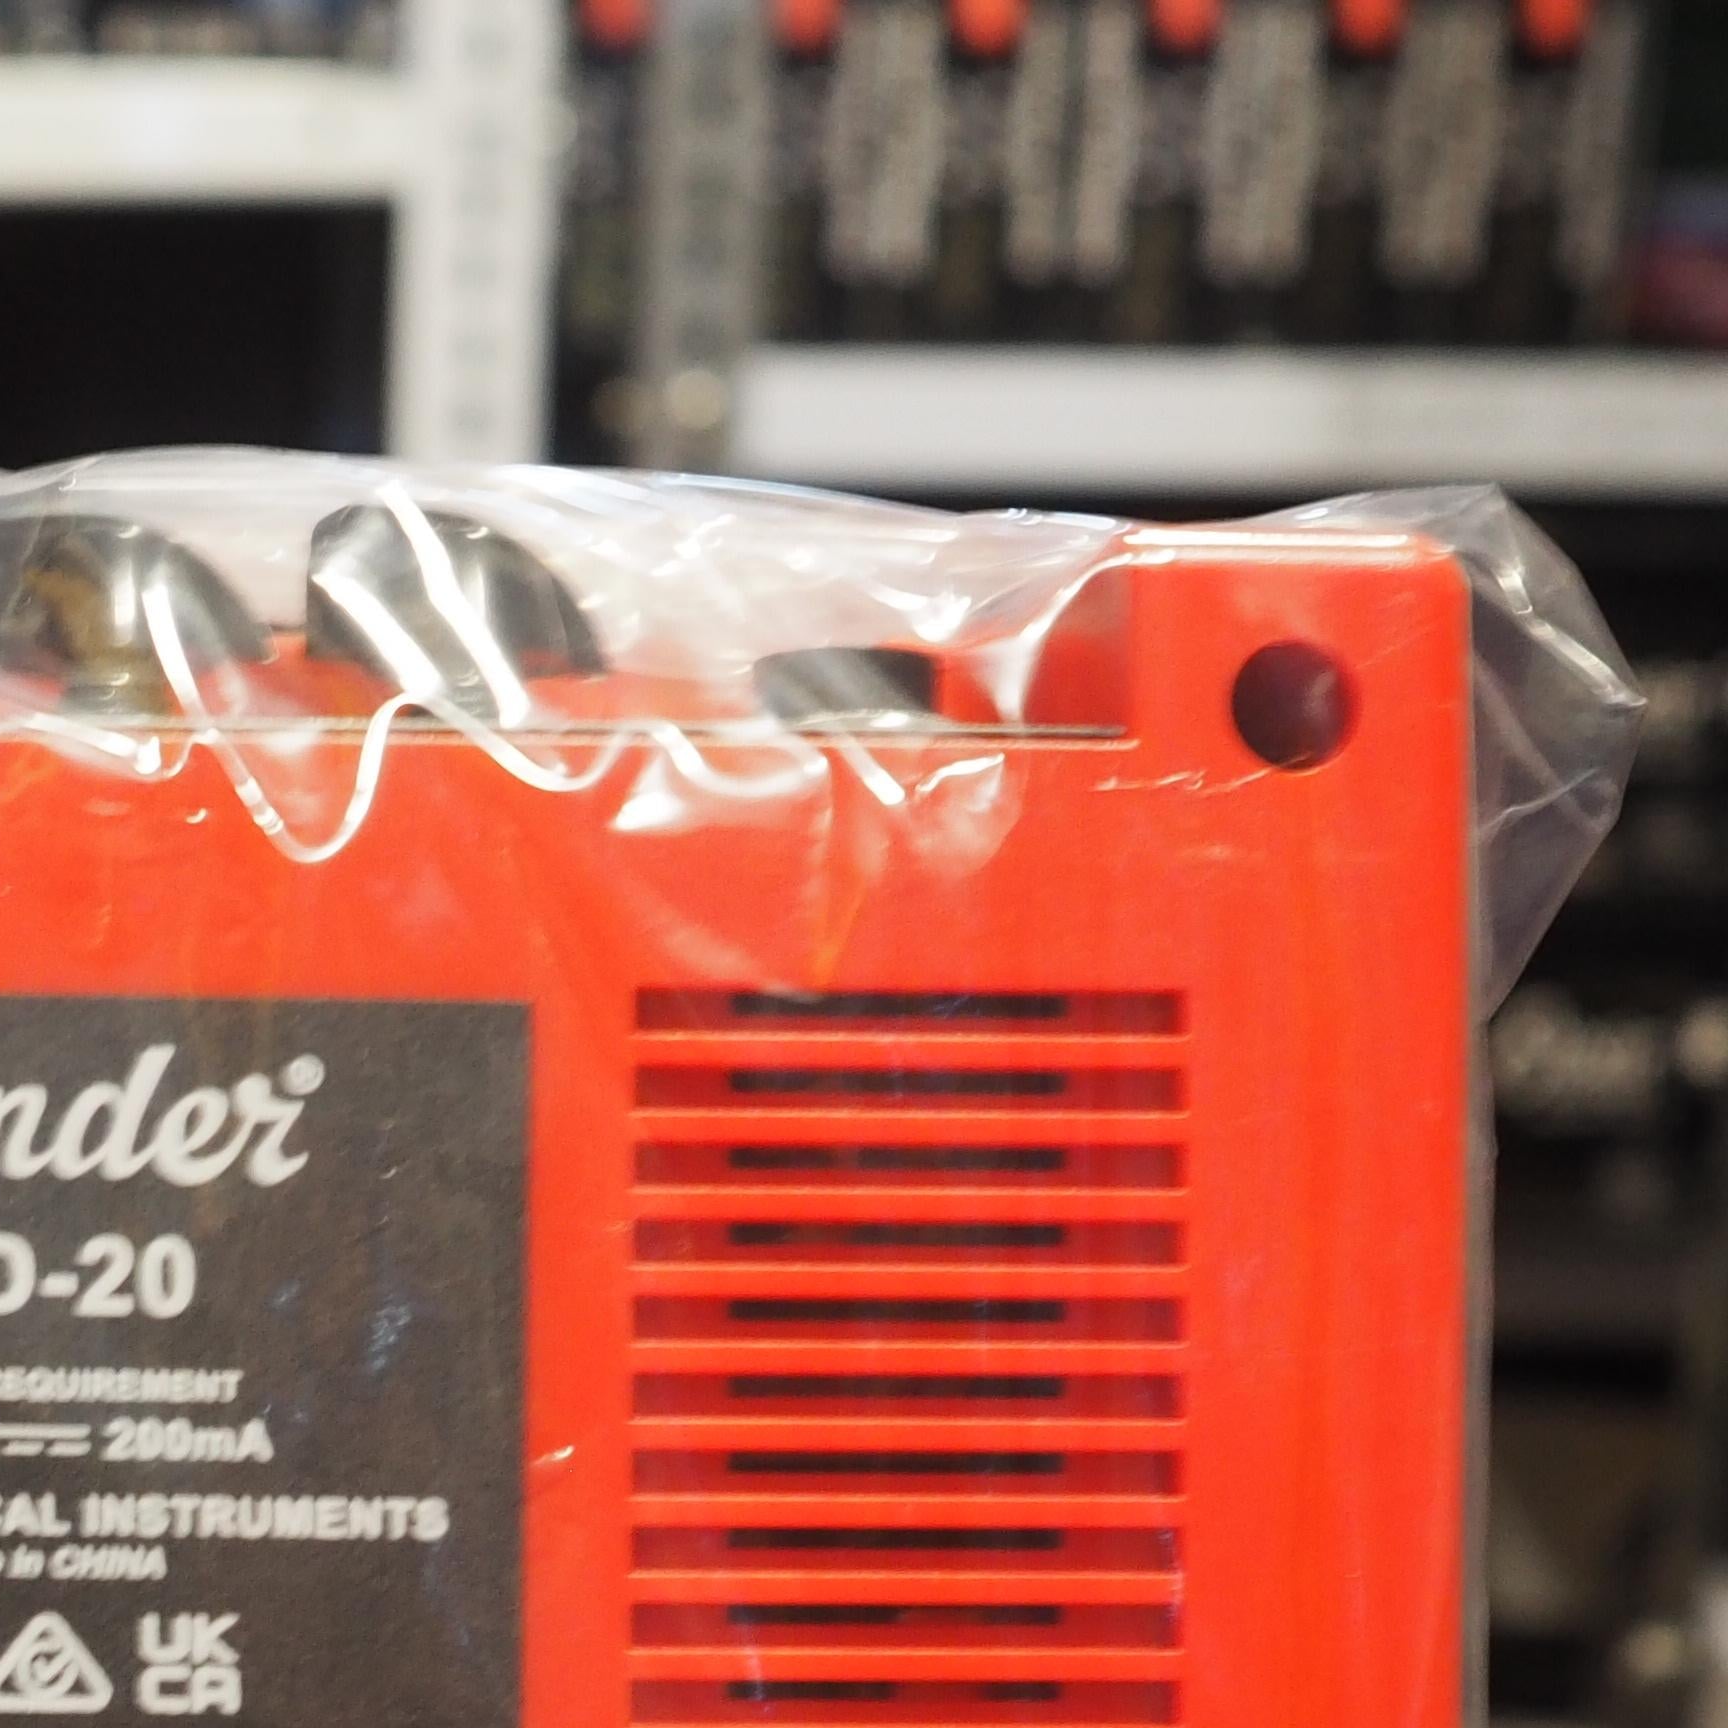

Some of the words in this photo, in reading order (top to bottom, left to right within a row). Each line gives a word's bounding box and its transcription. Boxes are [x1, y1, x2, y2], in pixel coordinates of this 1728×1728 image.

[100, 1416, 275, 1464] 200mA
[79, 1491, 451, 1543] INSTRUMENTS
[7, 1543, 45, 1579] in
[47, 1544, 168, 1580] CHINA
[134, 1611, 242, 1664] UK
[134, 1665, 243, 1716] CA
